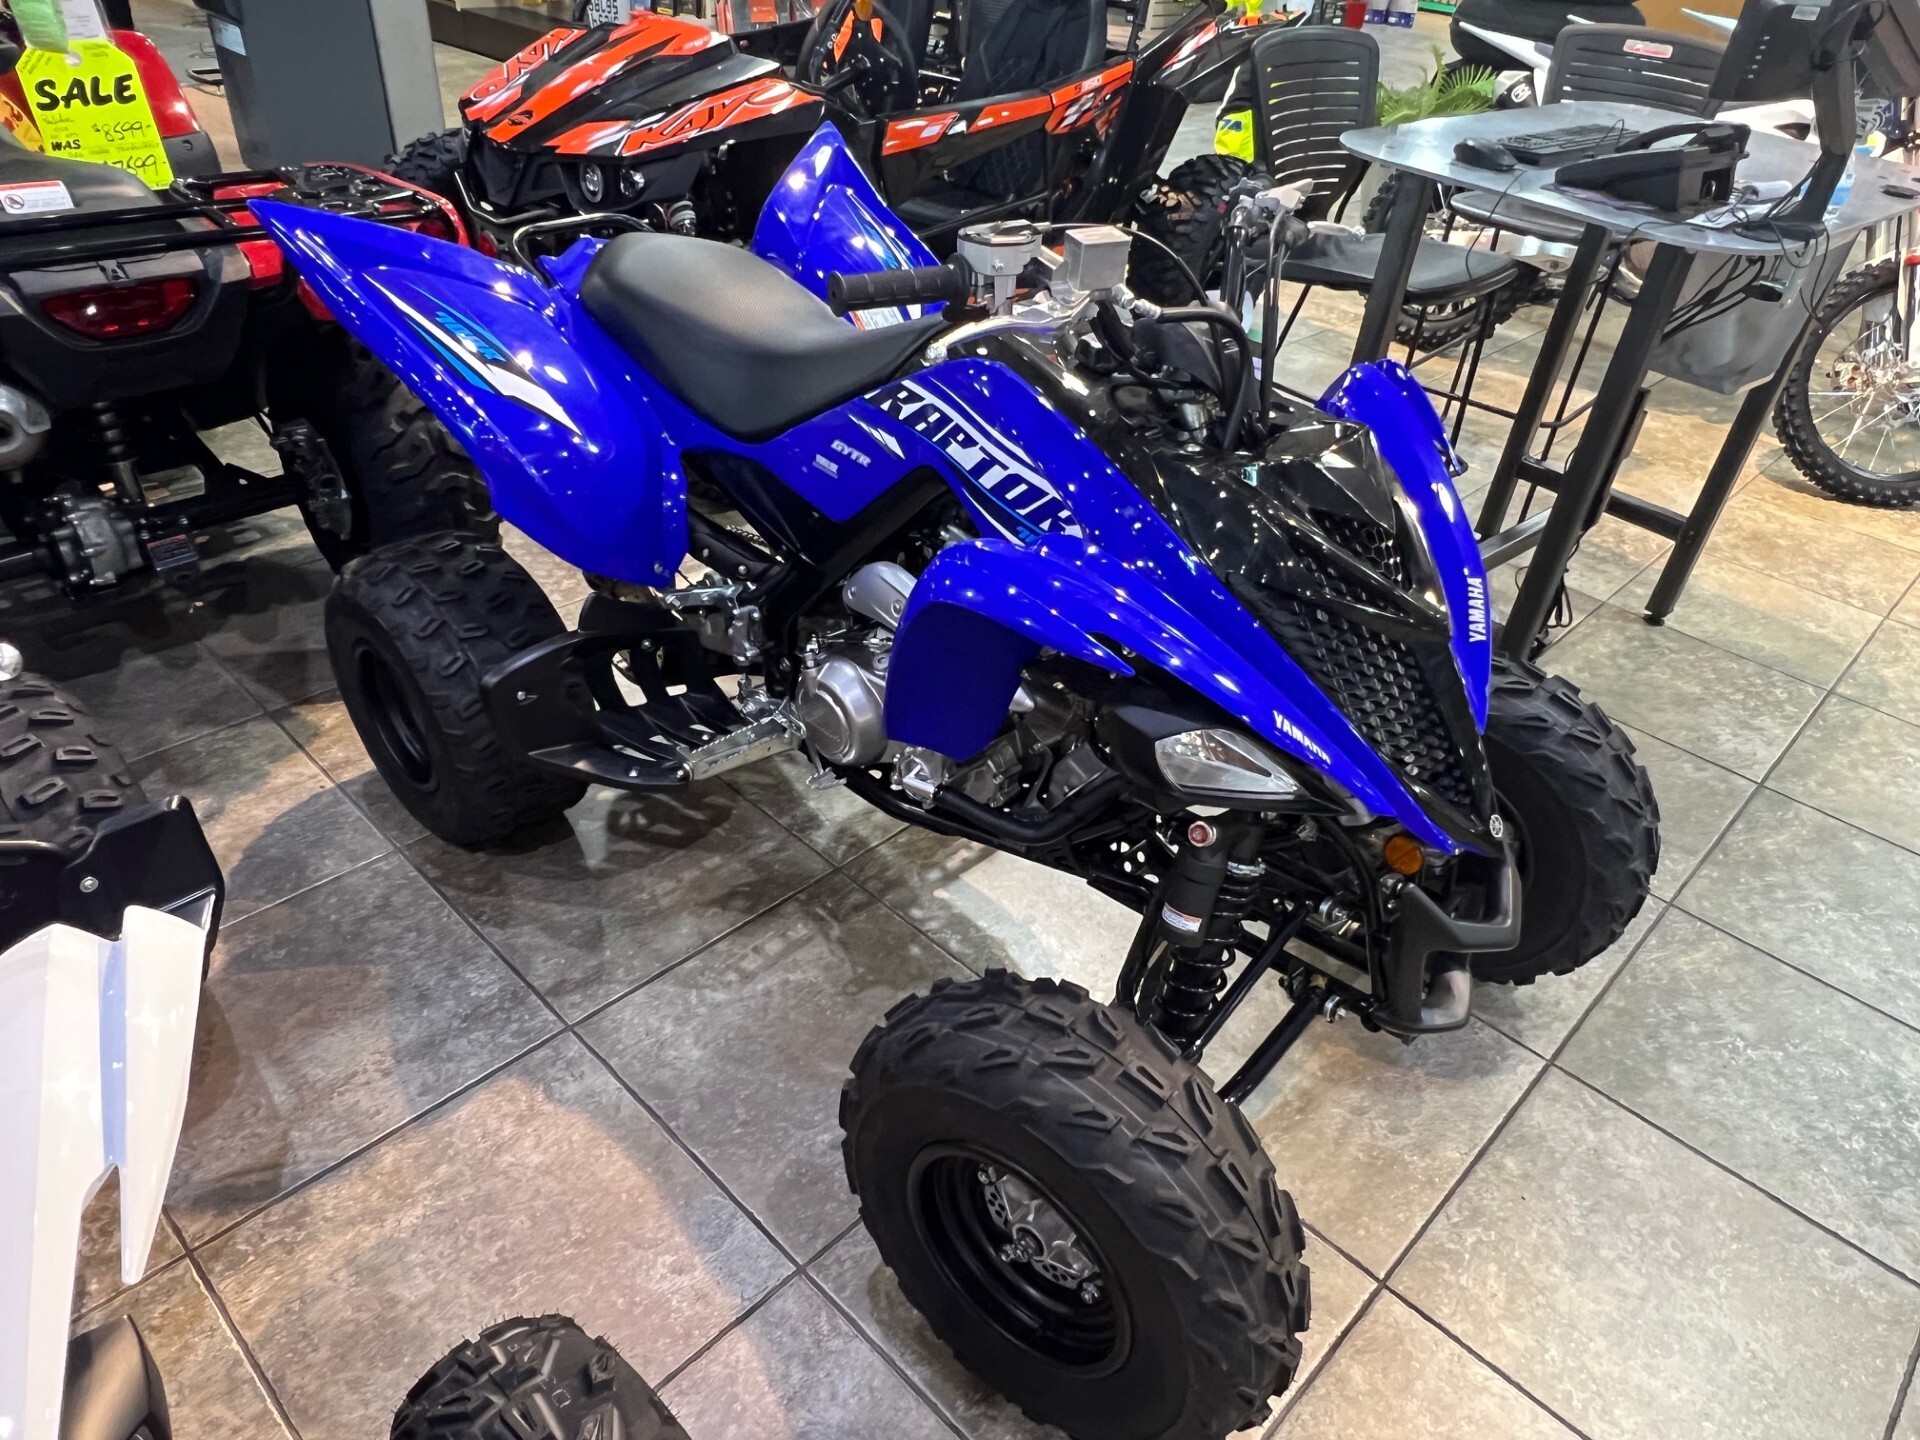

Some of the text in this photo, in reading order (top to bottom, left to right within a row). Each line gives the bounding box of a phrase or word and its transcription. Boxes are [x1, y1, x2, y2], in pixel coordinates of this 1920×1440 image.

[34, 73, 137, 112] SALE
[615, 81, 798, 157] KAYO
[51, 139, 81, 152] WAS
[830, 439, 872, 468] GYTR
[866, 385, 1084, 537] RAPTOR
[1466, 577, 1488, 643] YAMAHA
[1272, 709, 1331, 766] YAMAHA
